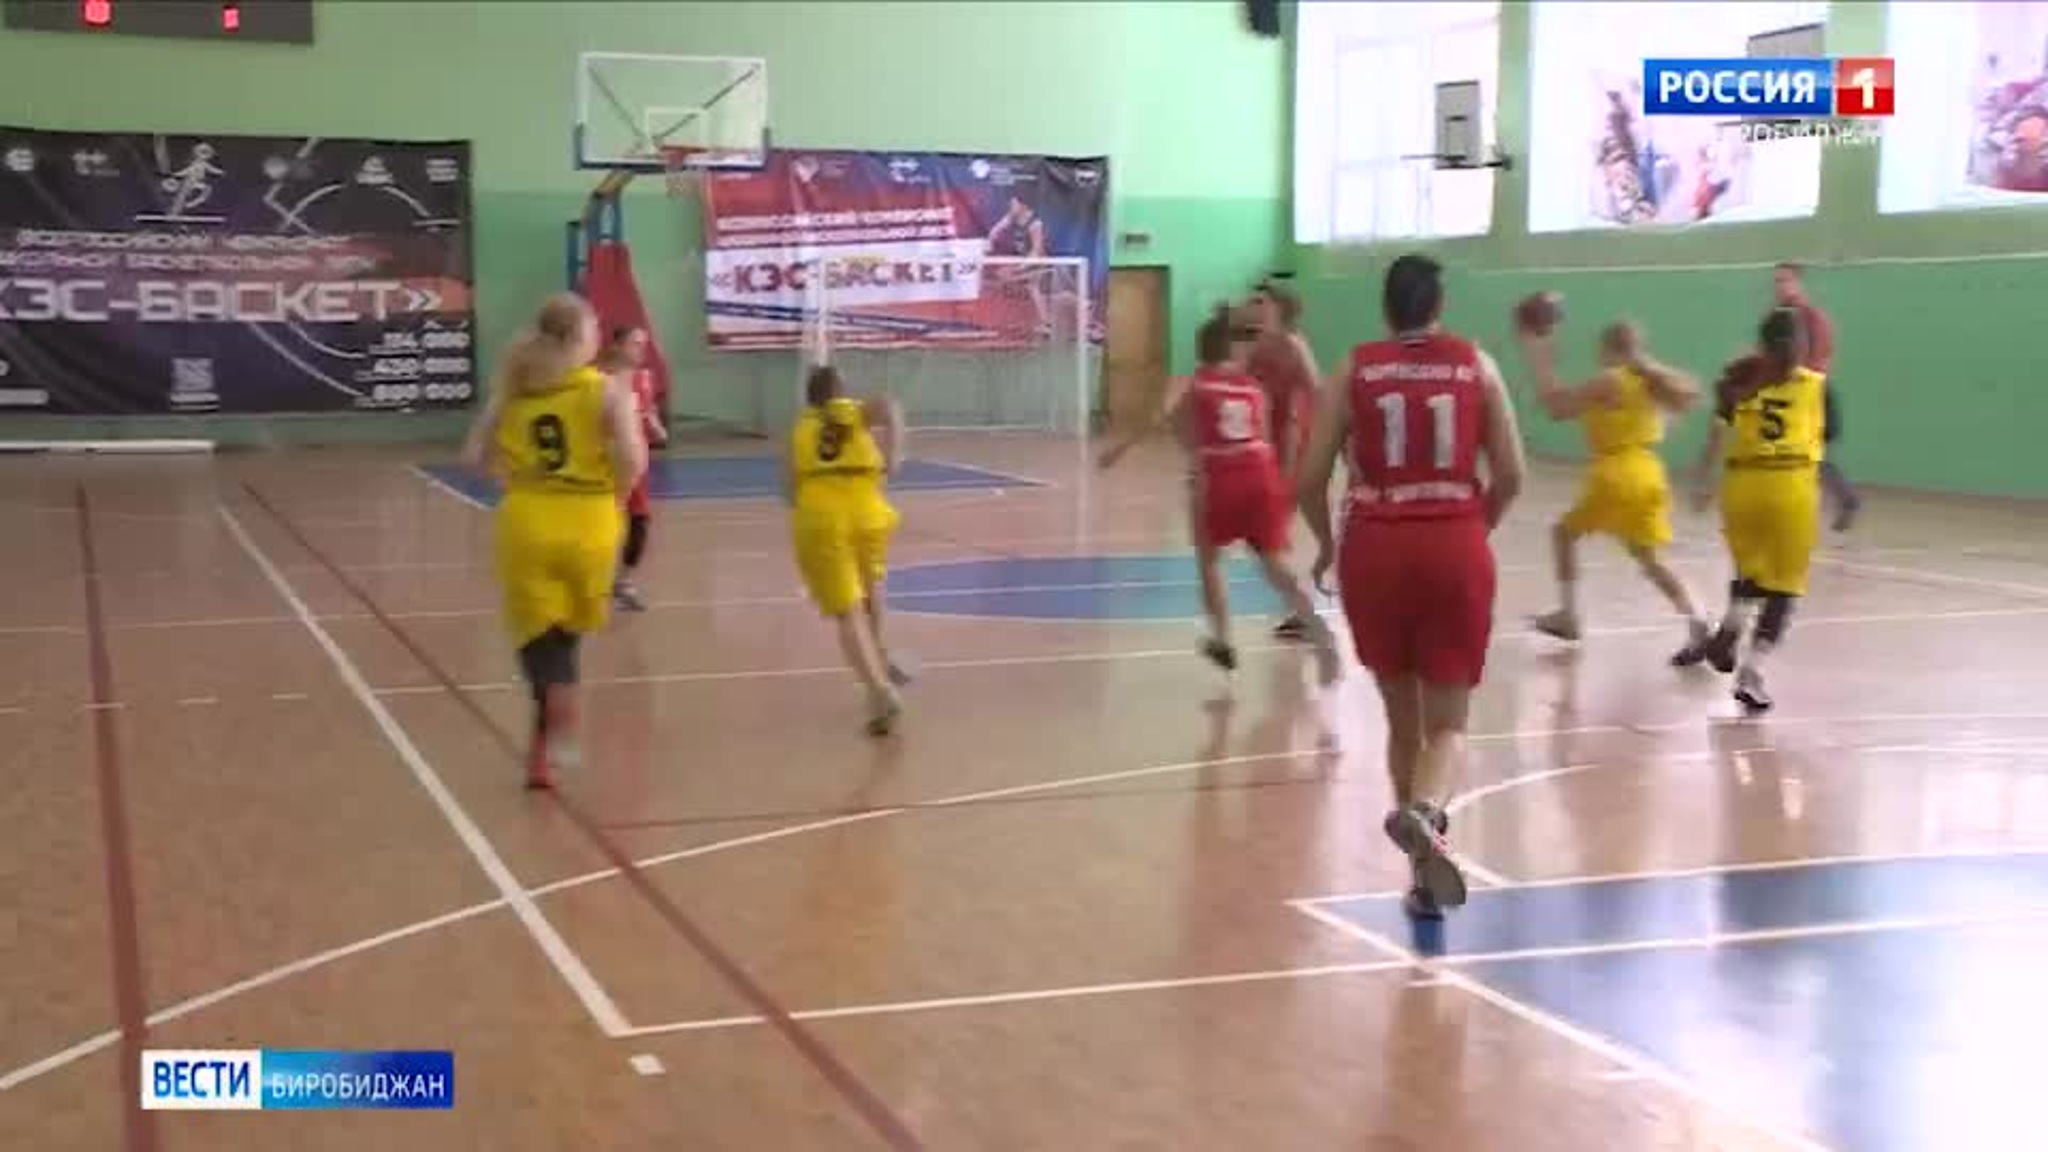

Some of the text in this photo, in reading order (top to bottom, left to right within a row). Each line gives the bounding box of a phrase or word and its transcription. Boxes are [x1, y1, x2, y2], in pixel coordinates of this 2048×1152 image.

[532, 412, 569, 472] 9
[1374, 391, 1456, 469] 11
[1759, 397, 1788, 440] 5
